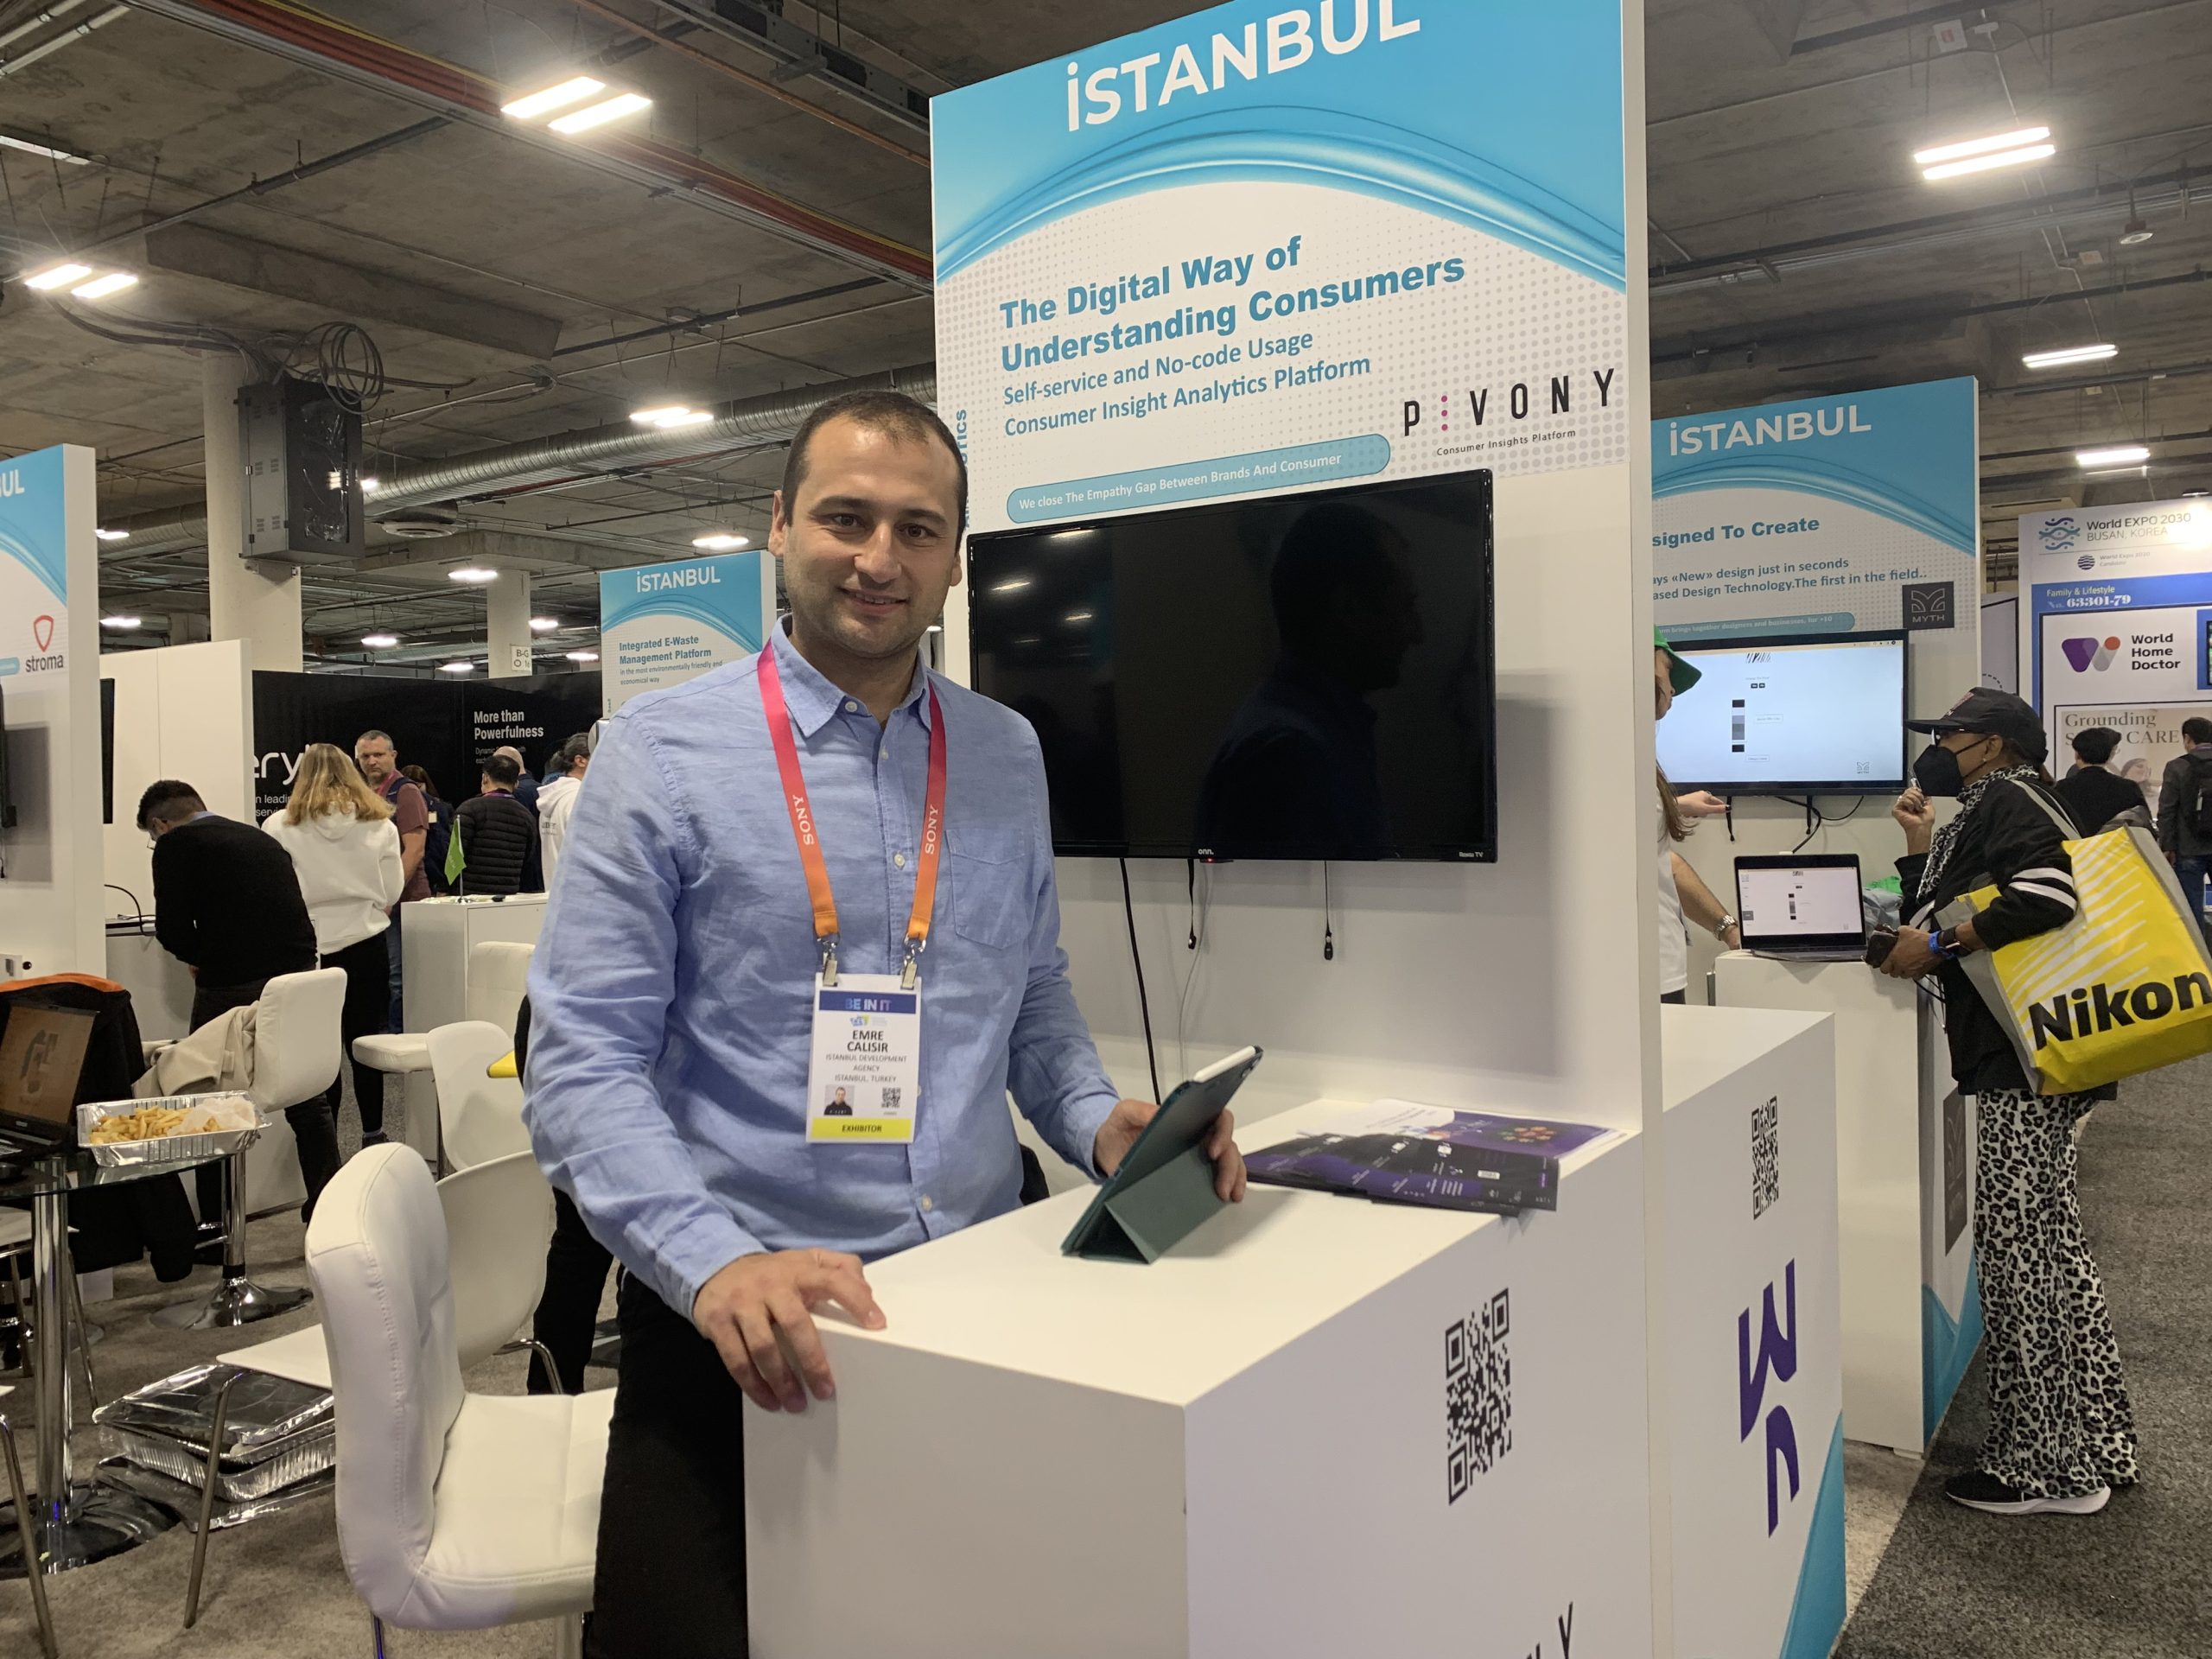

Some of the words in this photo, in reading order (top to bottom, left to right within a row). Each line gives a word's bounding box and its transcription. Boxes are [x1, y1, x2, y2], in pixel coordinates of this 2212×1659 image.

[1000, 298, 1057, 328] The
[1068, 265, 1170, 315] Digital
[1181, 253, 1255, 289] Way
[1266, 235, 1302, 271] of
[1002, 304, 1236, 372] Understanding
[1249, 257, 1465, 321] Consumers
[1004, 372, 1108, 405] Self-service
[1113, 359, 1149, 385] and
[1156, 344, 1242, 377] No-code
[1249, 333, 1313, 359] Usage
[1005, 407, 1097, 436] Consumer
[1103, 391, 1168, 420] Insight
[1173, 376, 1268, 407] Analytics
[1274, 358, 1370, 390] Platform
[1436, 442, 1485, 456] Consumer
[1488, 435, 1529, 448] Insights
[1532, 429, 1577, 442] Platform
[1019, 498, 1037, 510] We
[1038, 493, 1063, 507] close
[1065, 492, 1084, 504] The
[1087, 485, 1133, 501] Empathy
[1135, 480, 1157, 495] Gap
[1160, 474, 1208, 491] Between
[1211, 467, 1250, 482] Brands
[1253, 462, 1277, 476] And
[1281, 454, 1342, 472] Consumer
[2087, 518, 2122, 531] World
[2125, 515, 2158, 528] EXPO
[2160, 512, 2191, 524] 2030
[1652, 526, 1715, 549] signed
[1721, 524, 1745, 539] To
[1751, 518, 1821, 537] Create
[2087, 529, 2128, 542] BUSAN,
[2131, 526, 2169, 537] KOREA
[1653, 575, 1669, 586] ays
[1716, 567, 1755, 579] design
[1758, 563, 1780, 577] just
[1784, 563, 1796, 573] in
[1799, 557, 1849, 571] seconds
[1653, 588, 1679, 600] ased
[1682, 585, 1721, 599] Design
[1821, 574, 1846, 586] first
[1849, 573, 1861, 584] in
[1865, 570, 1886, 582] the
[2046, 588, 2072, 597] Family
[2082, 585, 2116, 595] Lifestyle
[2066, 594, 2132, 608] 63301-79
[1911, 613, 1946, 623] MYTH
[620, 639, 662, 652] Integrated
[664, 635, 699, 646] E-Waste
[2131, 633, 2174, 645] World
[620, 651, 673, 664] Management
[675, 648, 712, 659] Platform
[2131, 647, 2174, 658] Home
[25, 655, 64, 672] stroma
[691, 660, 712, 669] friendly
[2131, 659, 2181, 671] Doctor
[474, 710, 499, 724] More
[501, 709, 524, 722] than
[2065, 711, 2158, 728] Grounding
[474, 725, 544, 741] Powerfulness
[2126, 729, 2180, 745] CARE
[792, 794, 815, 846] SONY
[925, 804, 938, 855] SONY
[845, 998, 861, 1010] BE
[864, 998, 877, 1011] IN
[880, 999, 892, 1011] IT
[2028, 971, 2212, 1051] Nikon
[852, 1029, 884, 1041] EMRE
[847, 1040, 888, 1053] CALISIR
[825, 1053, 857, 1062] ISTANBUL
[859, 1054, 907, 1063] DEVELOPMENT
[853, 1064, 880, 1072] AGENCY
[871, 1074, 897, 1083] TURKEY
[842, 1124, 882, 1133] EXHIBITOR
